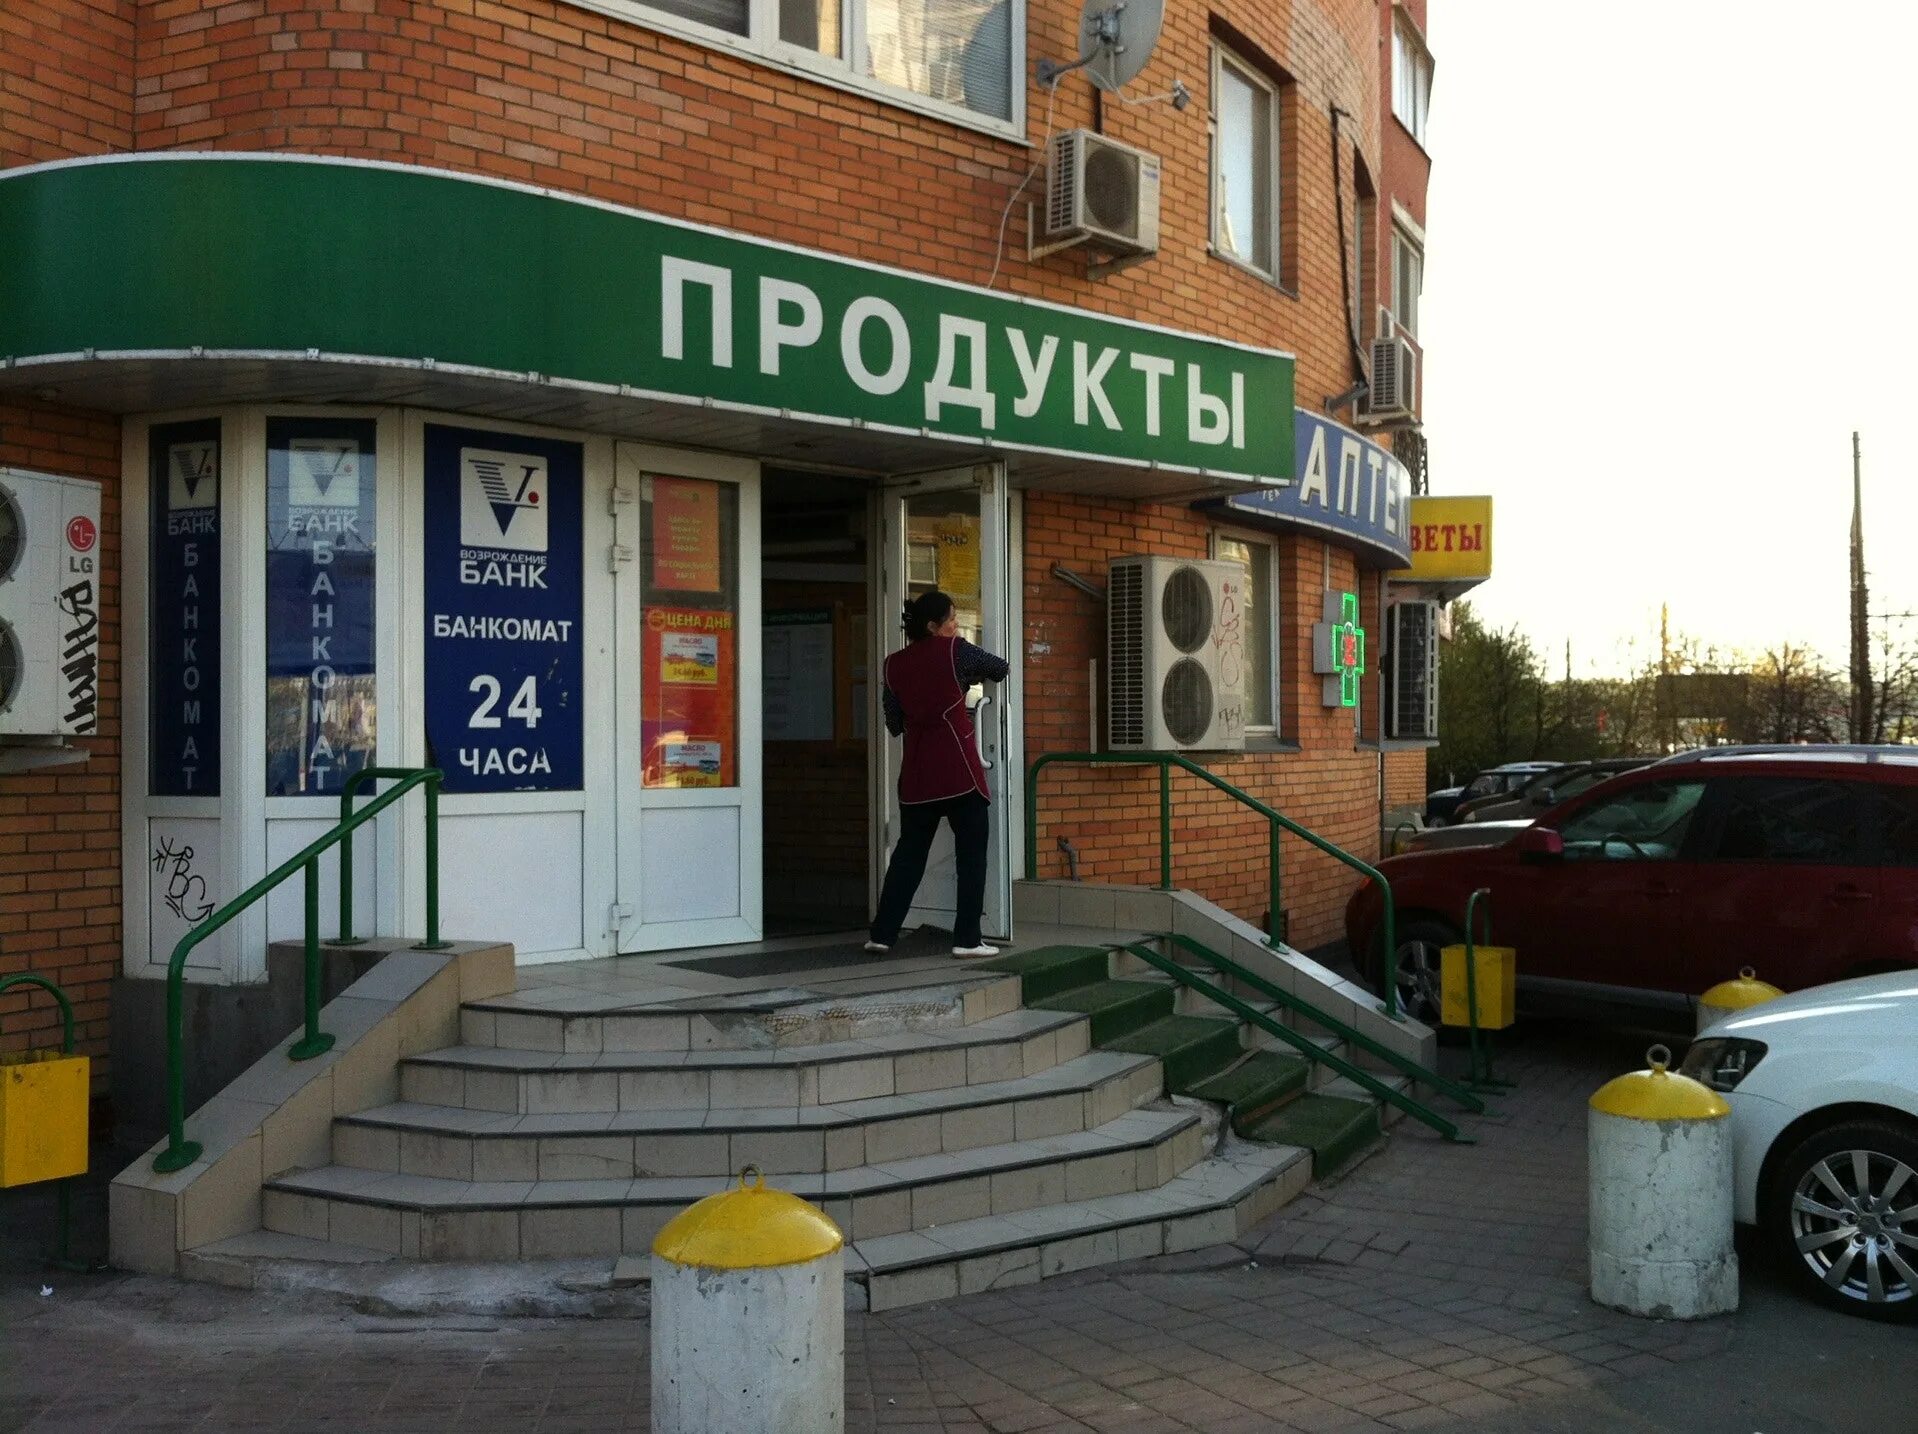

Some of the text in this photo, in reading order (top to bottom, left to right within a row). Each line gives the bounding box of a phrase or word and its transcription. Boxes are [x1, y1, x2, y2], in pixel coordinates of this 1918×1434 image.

[661, 254, 1246, 450] ПРОДУКТЫ
[168, 516, 217, 536] БАНК
[288, 514, 359, 533] БАНК
[1410, 523, 1484, 552] ВЕТЫ
[69, 555, 94, 574] LG
[460, 549, 548, 565] ВОЗРОЖДЕНИЕ
[460, 560, 549, 589] БАНК
[434, 614, 573, 642] БАНКОМАТ
[667, 612, 702, 628] ЦЕНА
[704, 616, 732, 631] ДНЯ
[181, 543, 200, 790] БАНКОМАТ
[310, 540, 336, 790] БАНКОМАТ
[468, 674, 542, 728] 24
[459, 747, 552, 775] ЧАСА
